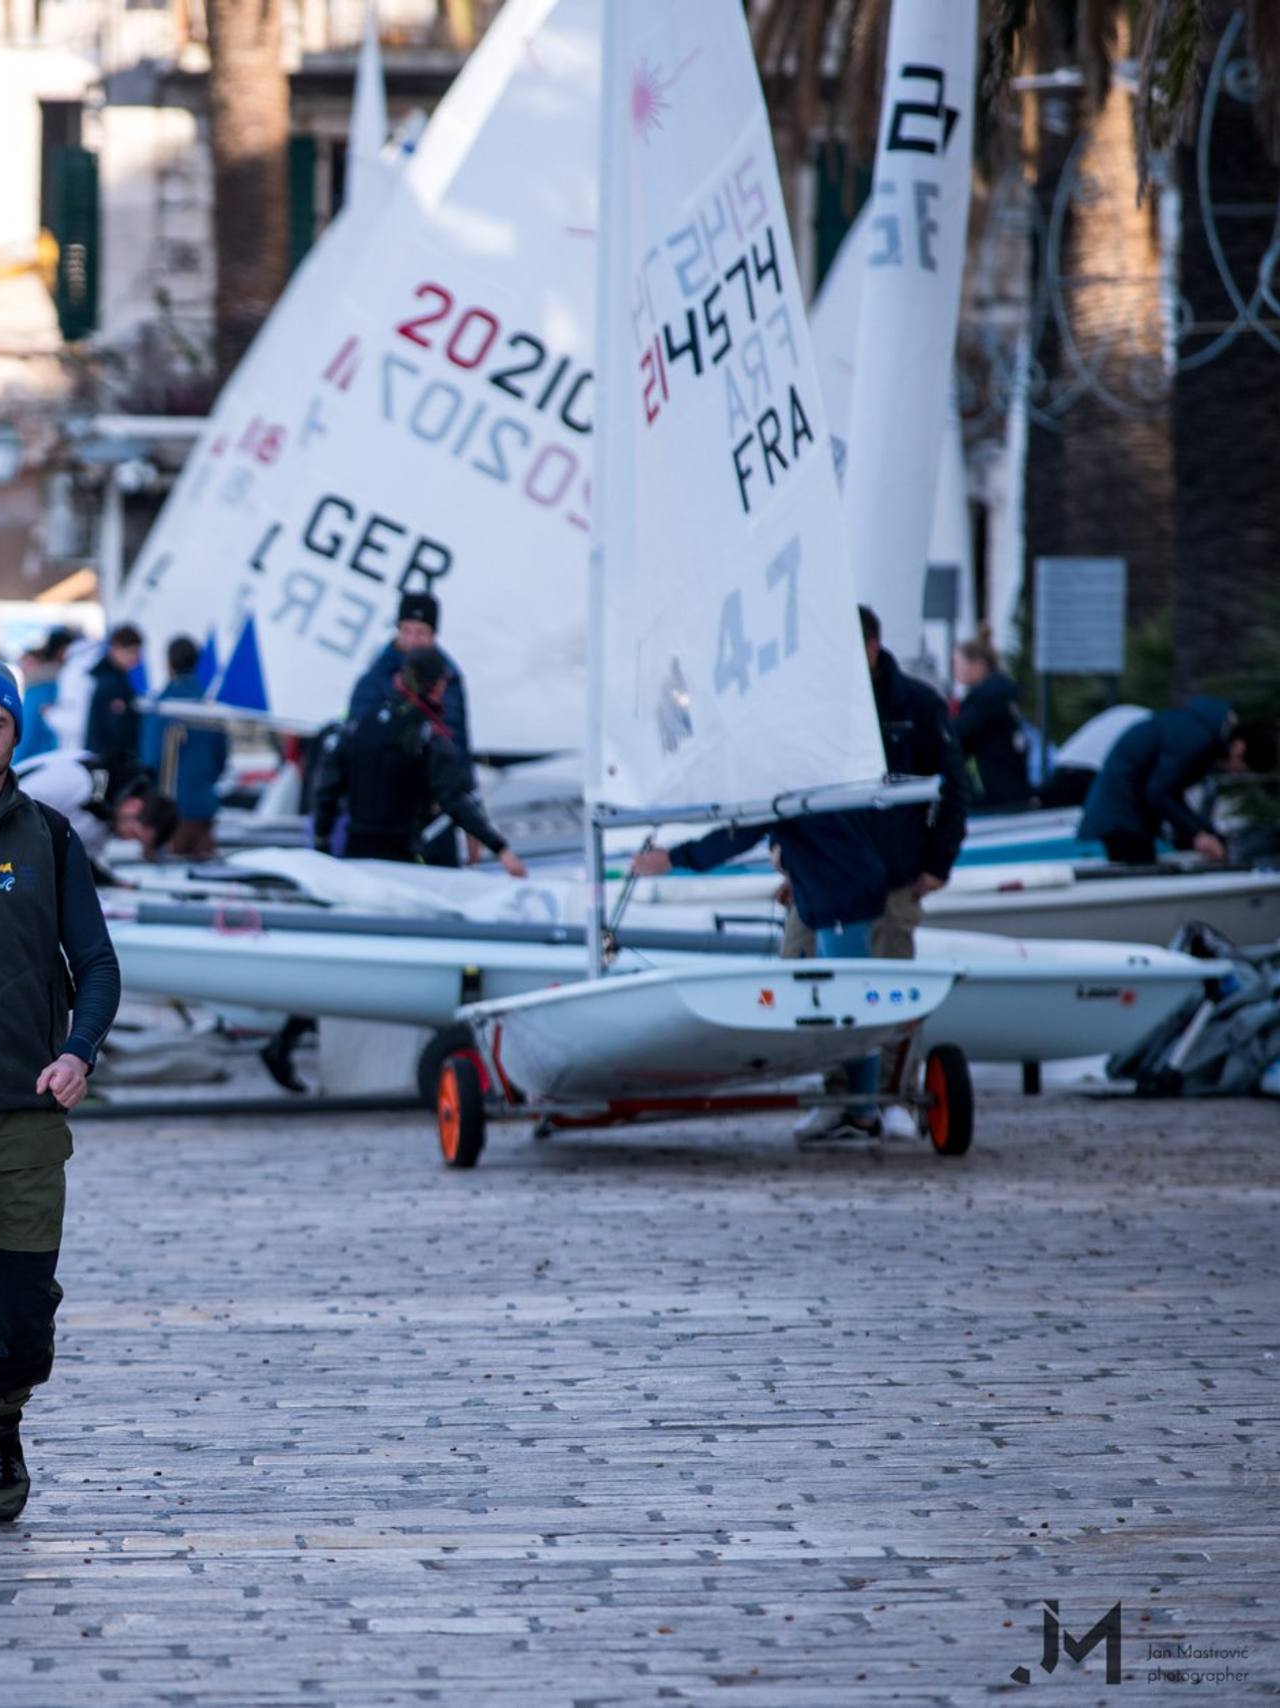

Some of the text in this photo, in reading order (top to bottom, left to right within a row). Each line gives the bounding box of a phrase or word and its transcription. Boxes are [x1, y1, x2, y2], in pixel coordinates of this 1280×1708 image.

[640, 225, 784, 427] 214574
[732, 382, 815, 515] FRA
[301, 494, 454, 597] GER
[713, 535, 802, 699] 4.7
